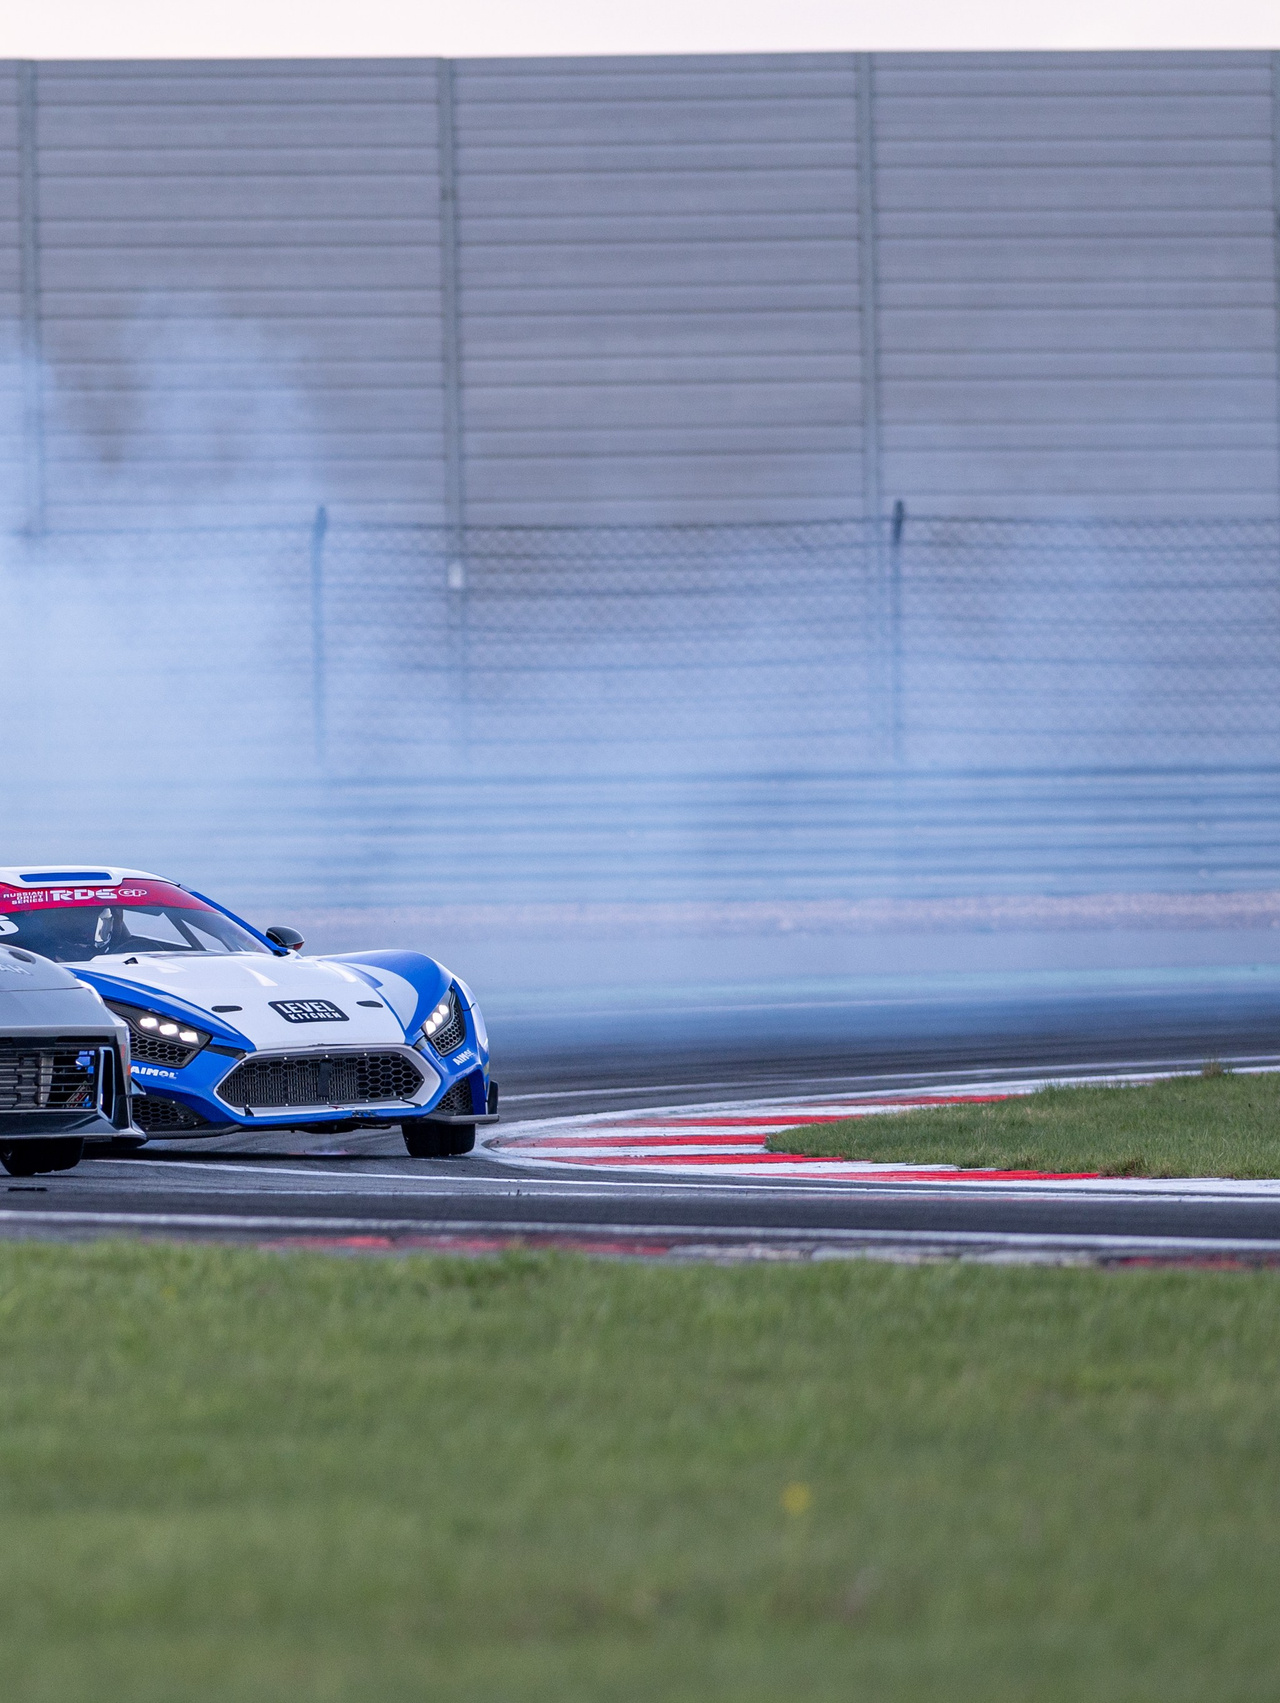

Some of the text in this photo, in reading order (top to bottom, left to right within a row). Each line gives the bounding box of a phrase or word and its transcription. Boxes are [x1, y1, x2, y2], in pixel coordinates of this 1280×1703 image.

[49, 889, 118, 901] RDS
[276, 1002, 336, 1014] LEVEL
[288, 1012, 342, 1021] KITCHEN
[130, 1065, 177, 1080] AIMOL
